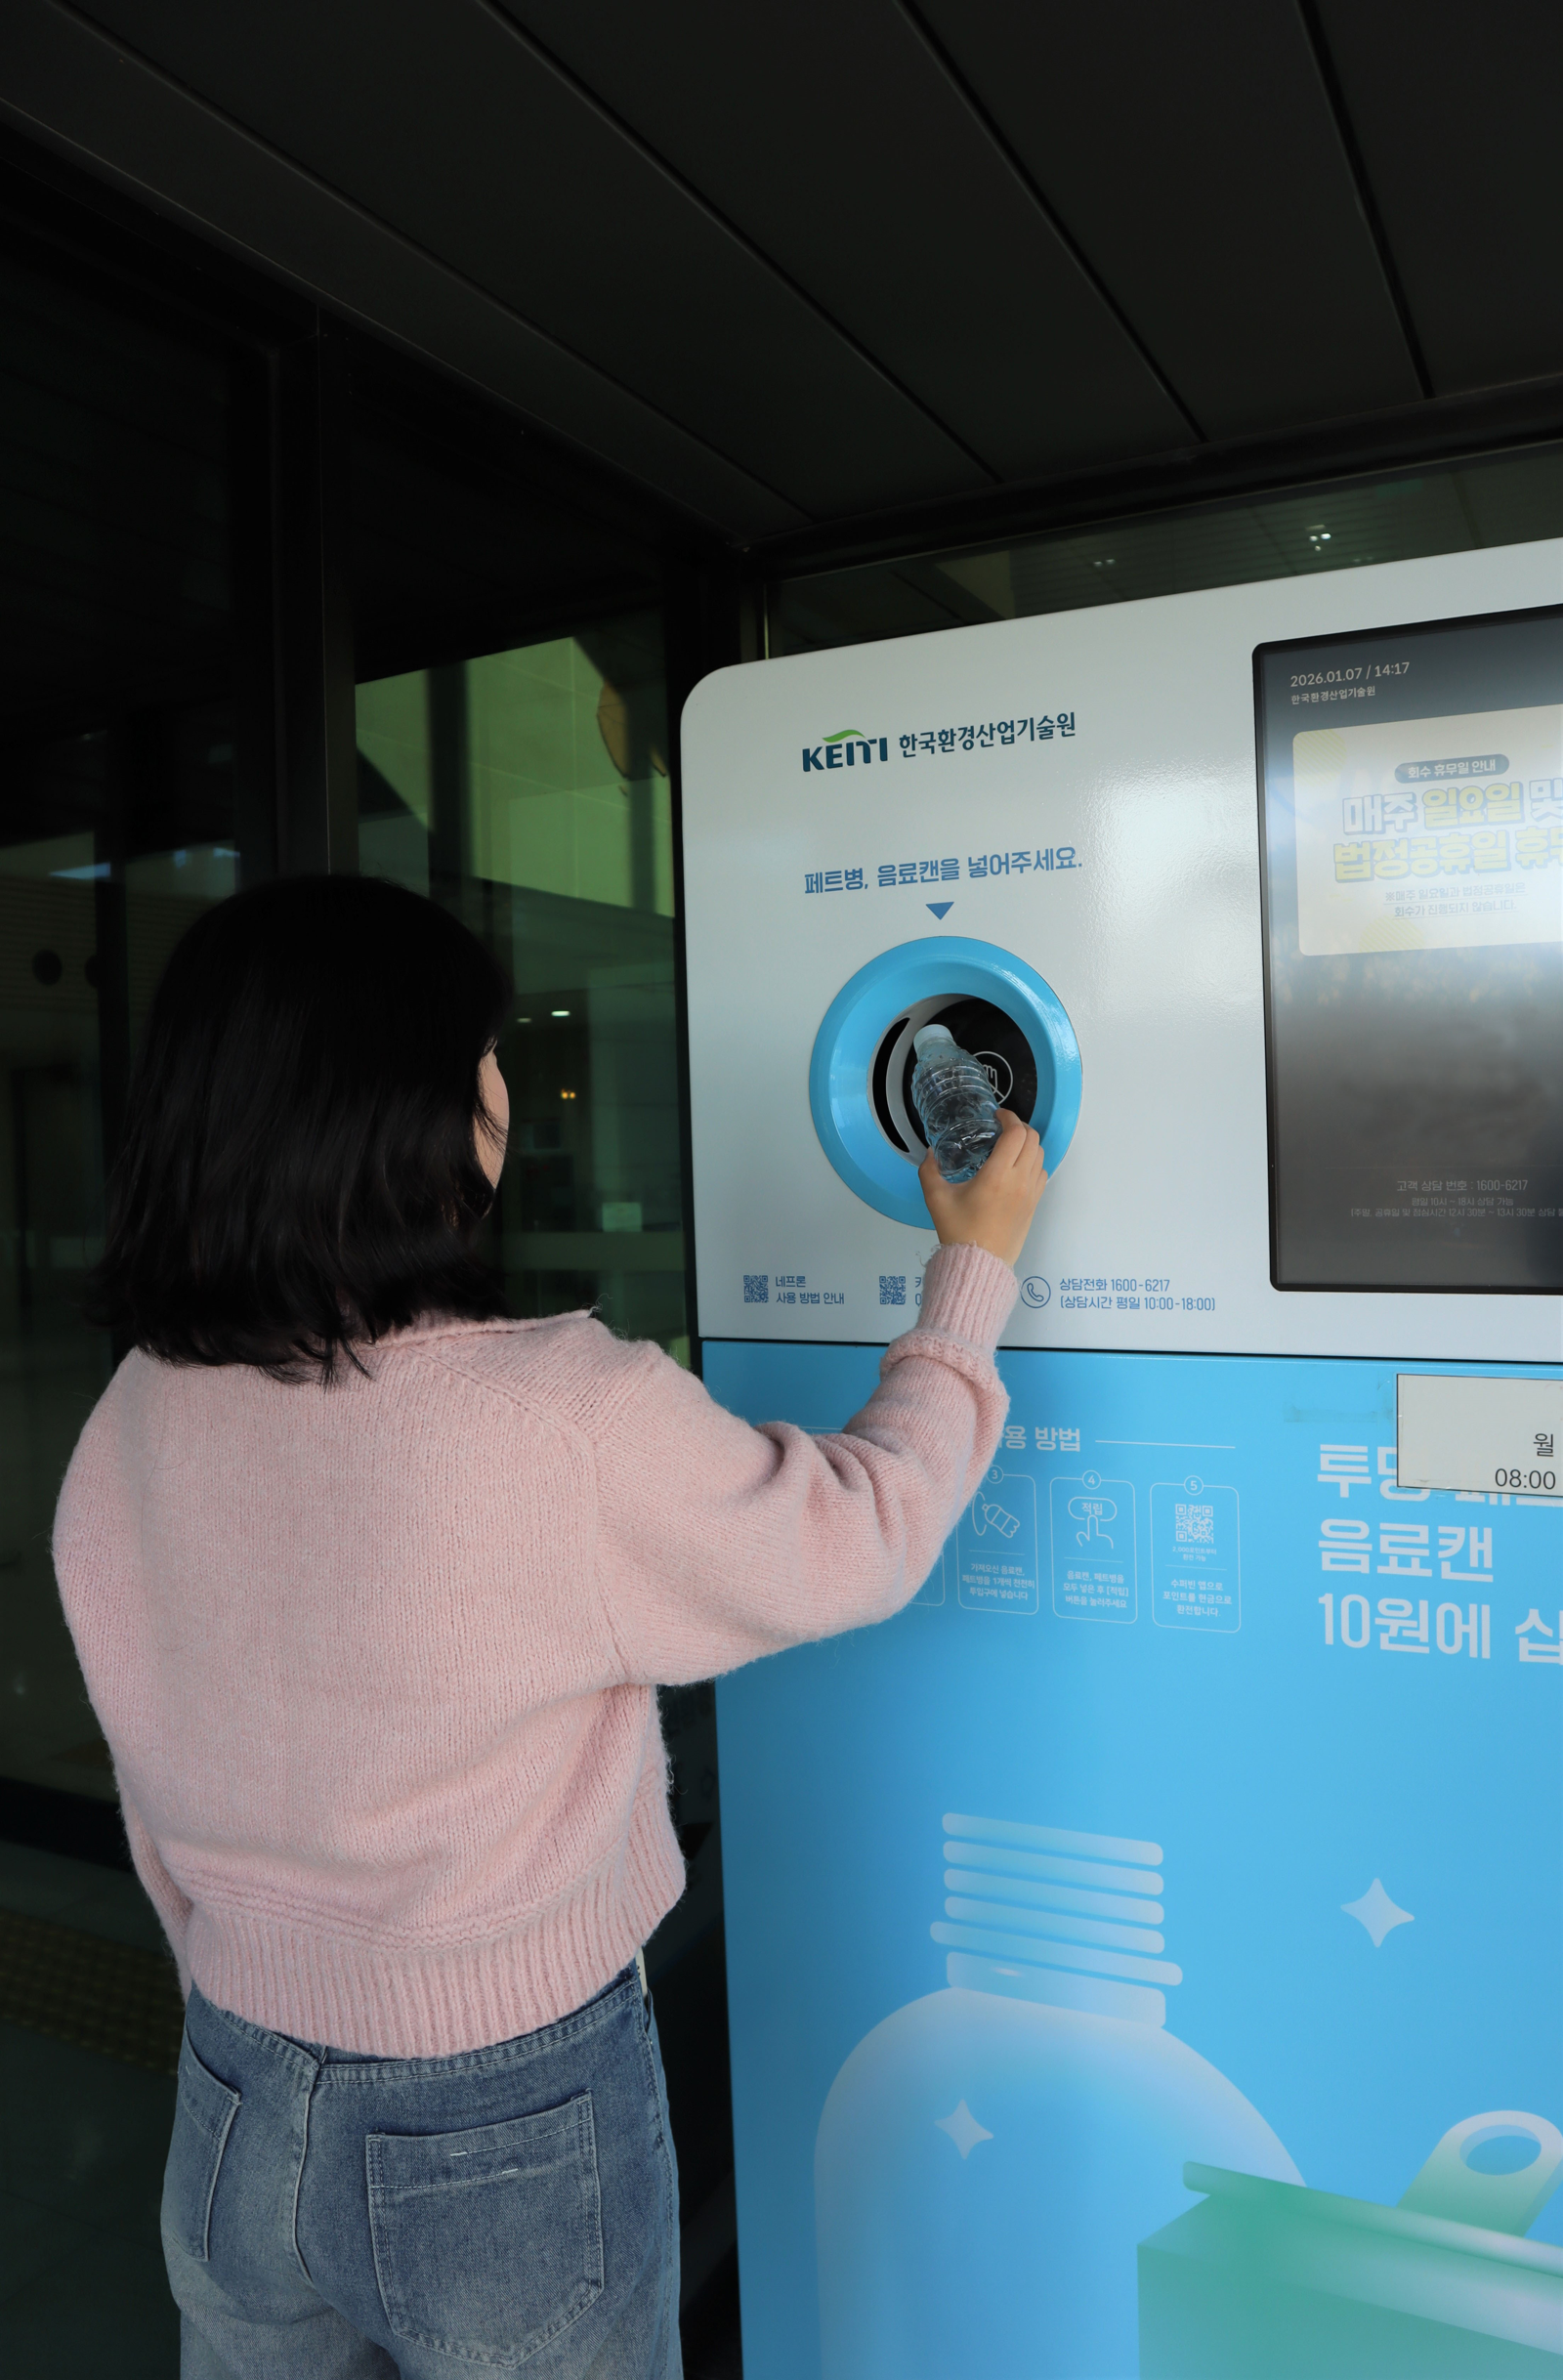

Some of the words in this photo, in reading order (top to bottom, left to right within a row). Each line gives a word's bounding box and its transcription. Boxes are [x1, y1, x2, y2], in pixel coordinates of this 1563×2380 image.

[1289, 667, 1363, 688] 2026.01.07
[1366, 665, 1372, 680] /
[1373, 661, 1411, 678] 14:17
[1290, 685, 1376, 705] 한국환경산업기술원
[802, 735, 889, 773] KEITI
[899, 711, 1077, 759] 한국환경산업기술원
[1408, 765, 1431, 779] 회수
[1434, 762, 1469, 776] 휴무일
[1471, 758, 1496, 773] 안내
[1341, 791, 1417, 835] 매주
[1421, 782, 1525, 830] 일요일
[1332, 829, 1511, 884] 법정공휴일
[804, 866, 869, 895] 페트병,
[876, 858, 960, 889] 음료캔을
[967, 846, 1082, 879] 넣어주세요.
[1418, 886, 1460, 900] 일요일과
[1462, 882, 1526, 897] 법정공휴일은
[1394, 904, 1425, 917] 회수가
[1427, 901, 1469, 915] 진행되지
[1472, 898, 1517, 913] 않습니다.
[1396, 1180, 1418, 1192] 고객
[1420, 1180, 1443, 1192] 상담
[1446, 1180, 1468, 1192] 번호
[1476, 1179, 1528, 1192] 1600-6217
[1412, 1197, 1428, 1207] 평일
[1430, 1197, 1447, 1207] 10시
[1457, 1197, 1474, 1207] 18시
[1477, 1197, 1495, 1207] 상담
[1497, 1197, 1514, 1207] 가능
[1374, 1208, 1400, 1217] 공휴일
[1413, 1208, 1446, 1217] 점심시간
[1449, 1208, 1465, 1217] 12시
[1467, 1208, 1486, 1217] 30분
[1497, 1208, 1514, 1217] 13시
[1516, 1208, 1535, 1217] 30분
[1538, 1208, 1555, 1217] 상담
[775, 1275, 807, 1288] 네프론
[1059, 1277, 1107, 1293] 상담전화
[1110, 1277, 1170, 1293] 1600-6217
[776, 1292, 796, 1304] 사용
[799, 1292, 821, 1304] 방법
[823, 1292, 845, 1305] 안내
[1060, 1295, 1113, 1310] (상담시간
[1116, 1295, 1141, 1310] 평일
[1143, 1295, 1215, 1312] 10:00-18:00)
[997, 1424, 1028, 1450] 용
[1035, 1426, 1081, 1453] 방법
[1534, 1432, 1554, 1458] 월
[991, 1469, 998, 1479] 3
[1087, 1475, 1096, 1485] 4
[1495, 1467, 1556, 1490] 08:00
[1190, 1481, 1198, 1491] 5
[1081, 1502, 1104, 1516] 적립
[1172, 1546, 1217, 1555] 2,000포인트부터
[1318, 1517, 1494, 1583] 음료캔
[1000, 1565, 1025, 1577] 음료캔,
[1067, 1570, 1092, 1582] 음료캔,
[1094, 1573, 1125, 1584] 페트병을
[961, 1574, 991, 1586] 페트병을
[993, 1576, 1012, 1588] 1개씩
[1013, 1577, 1035, 1589] 천천히
[1170, 1579, 1196, 1591] 수퍼빈
[1198, 1581, 1224, 1592] 앱으로
[969, 1587, 998, 1598] 투입구에
[999, 1589, 1029, 1600] 넣습니다
[1063, 1583, 1078, 1593] 모두
[1080, 1584, 1095, 1594] 넣은
[1097, 1585, 1105, 1594] 후
[1106, 1585, 1129, 1597] [적립]
[1065, 1594, 1088, 1606] 버튼을
[1089, 1596, 1127, 1609] 눌러주세요
[1162, 1591, 1197, 1603] 포인트를
[1198, 1593, 1233, 1605] 현금으로
[1176, 1604, 1221, 1618] 환전합니다.
[1318, 1593, 1491, 1660] 10원에
